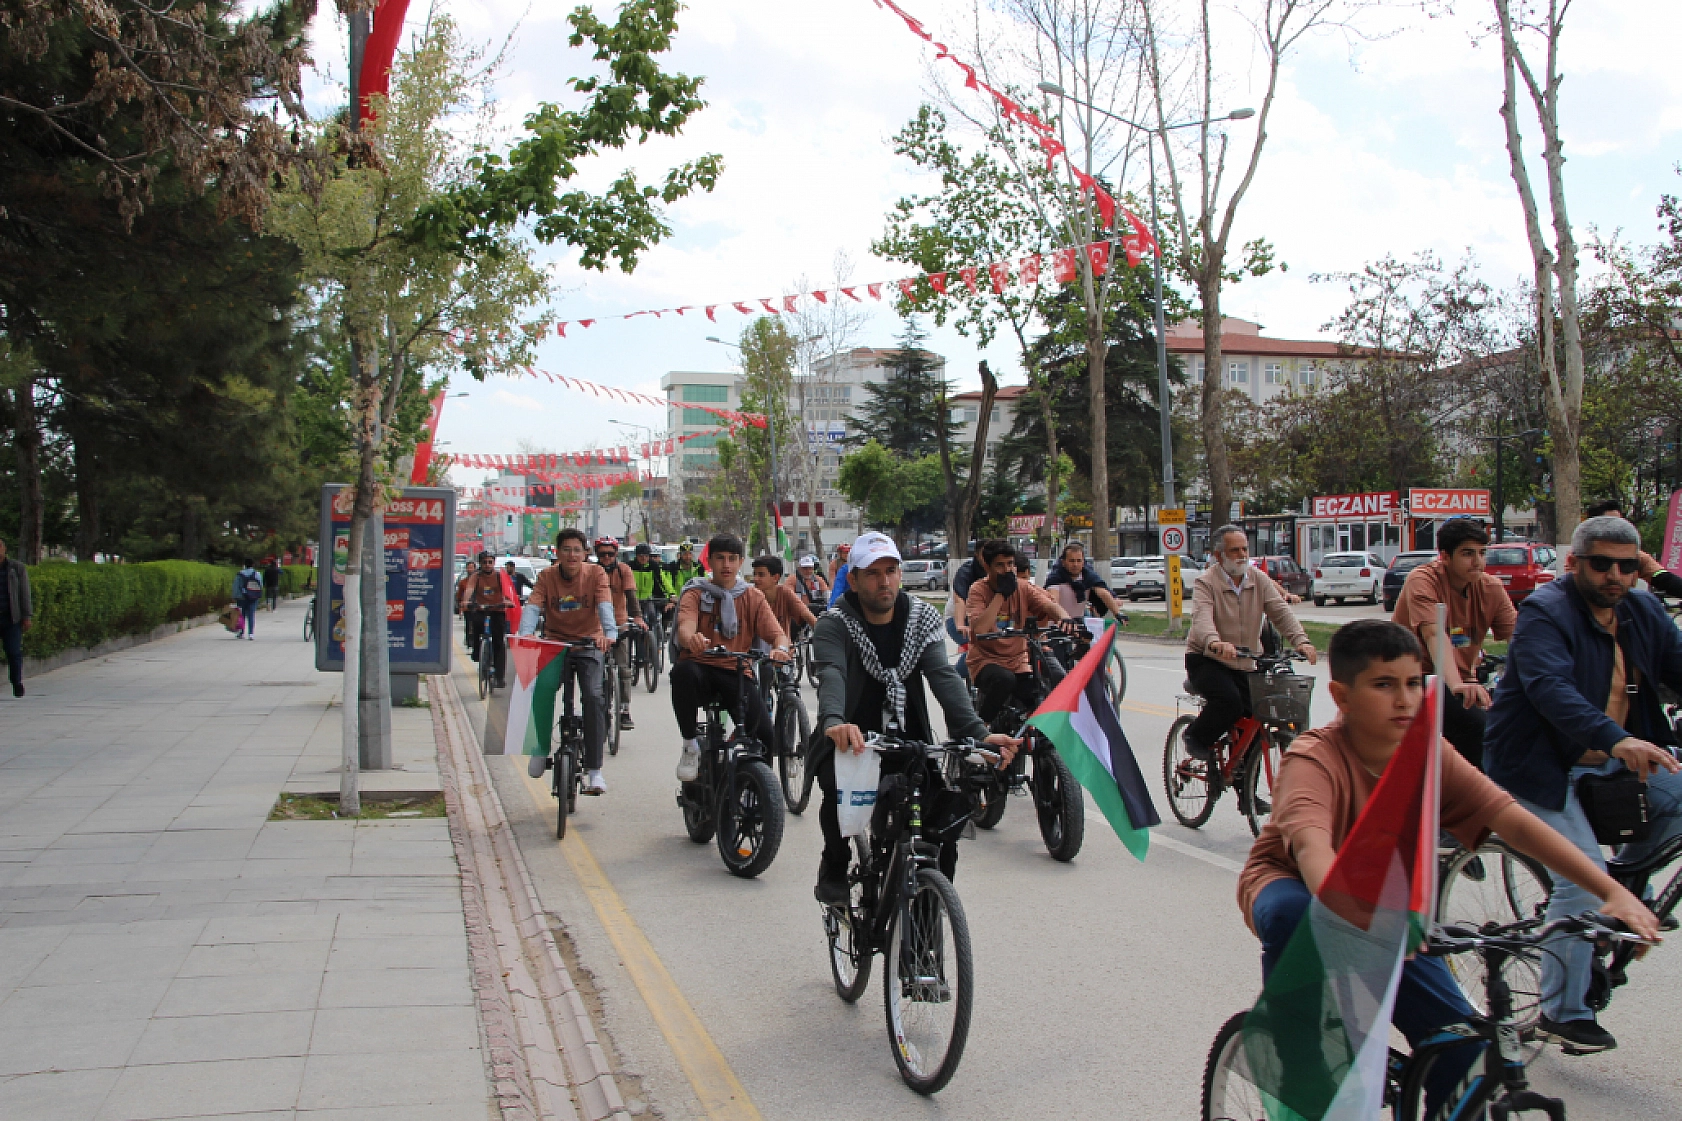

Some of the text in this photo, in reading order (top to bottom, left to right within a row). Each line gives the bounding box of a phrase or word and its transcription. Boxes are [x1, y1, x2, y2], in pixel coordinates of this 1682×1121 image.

[1315, 494, 1391, 516] ECZANE
[1412, 493, 1488, 509] ECZANE
[1166, 534, 1180, 545] 30
[1171, 565, 1179, 608] OKUL
